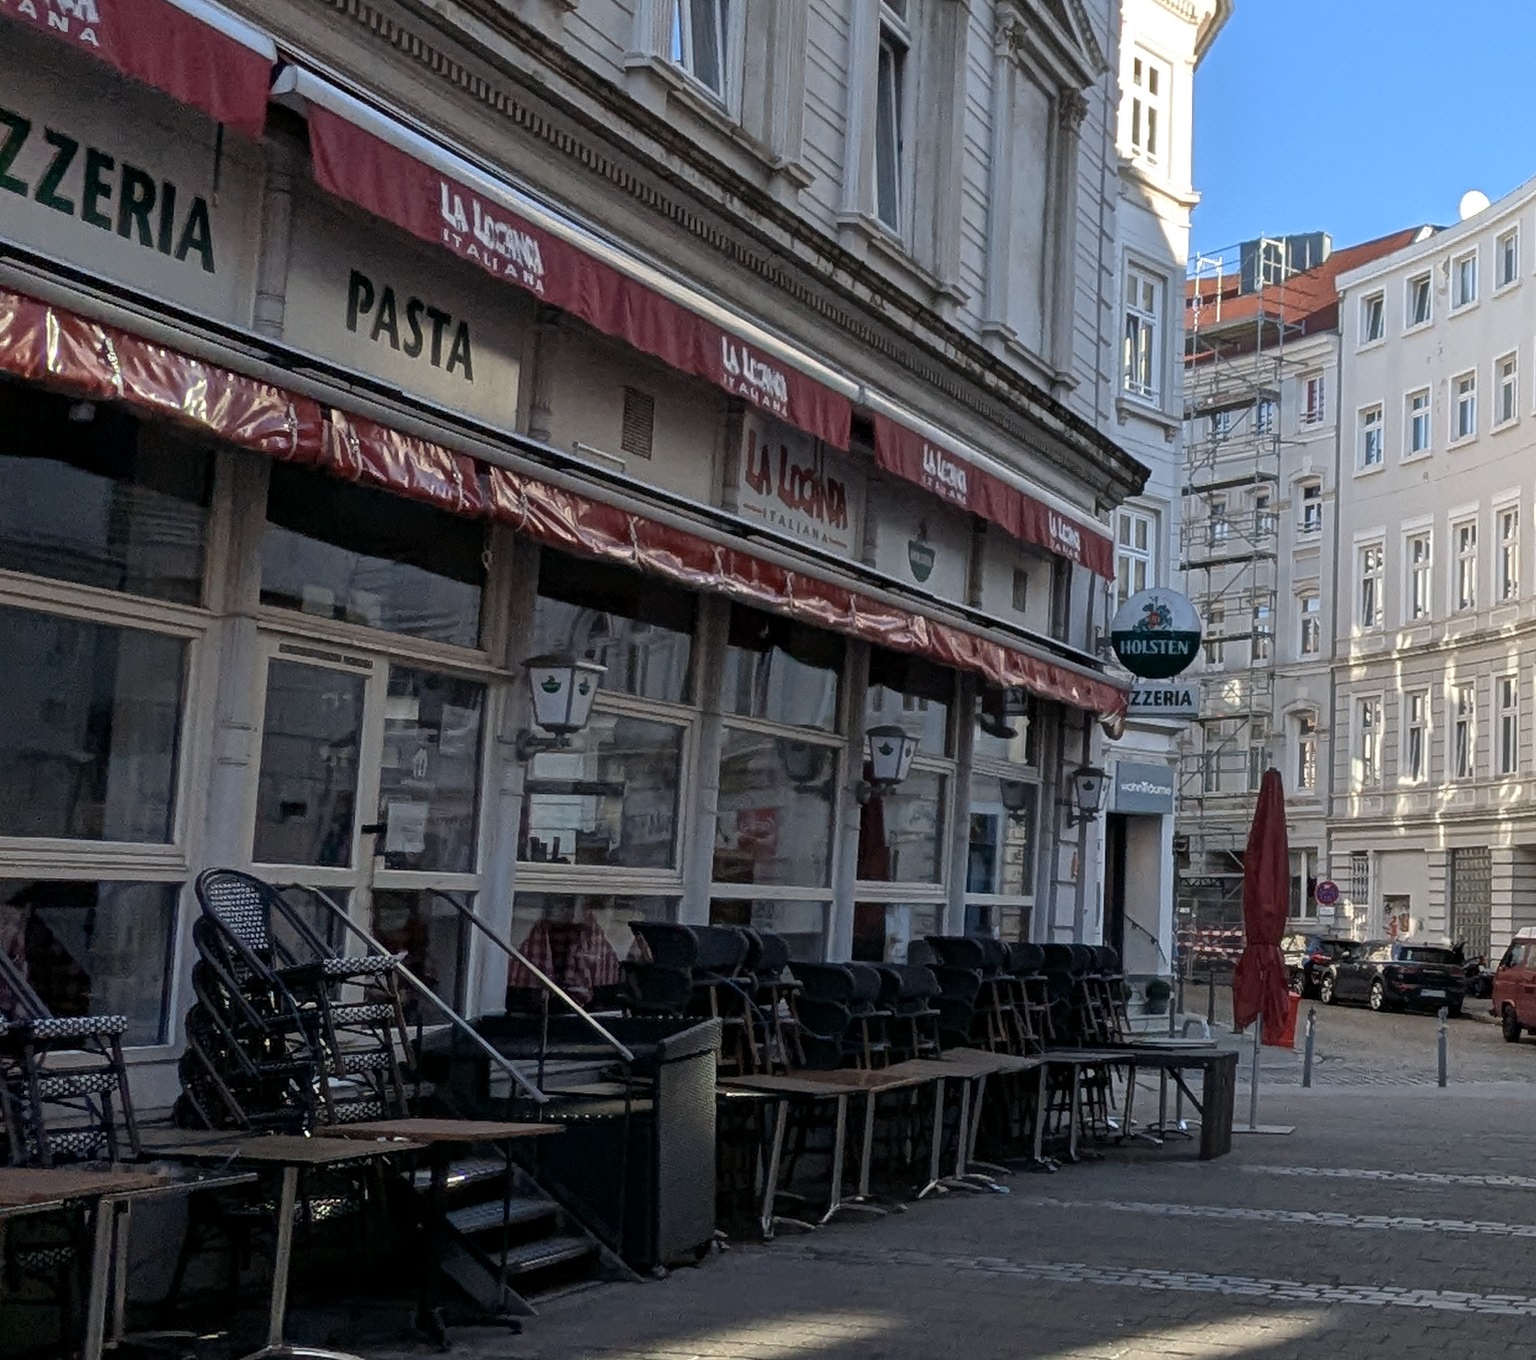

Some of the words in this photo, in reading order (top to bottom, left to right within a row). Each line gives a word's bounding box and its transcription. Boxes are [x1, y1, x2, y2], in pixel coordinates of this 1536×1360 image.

[440, 181, 469, 233] LA
[442, 227, 545, 295] ITALIANA
[346, 267, 474, 385] PASTA
[722, 336, 741, 375] LA
[745, 429, 773, 496] LA
[762, 507, 828, 544] ITALIANA
[1120, 639, 1189, 655] HOLSTEN
